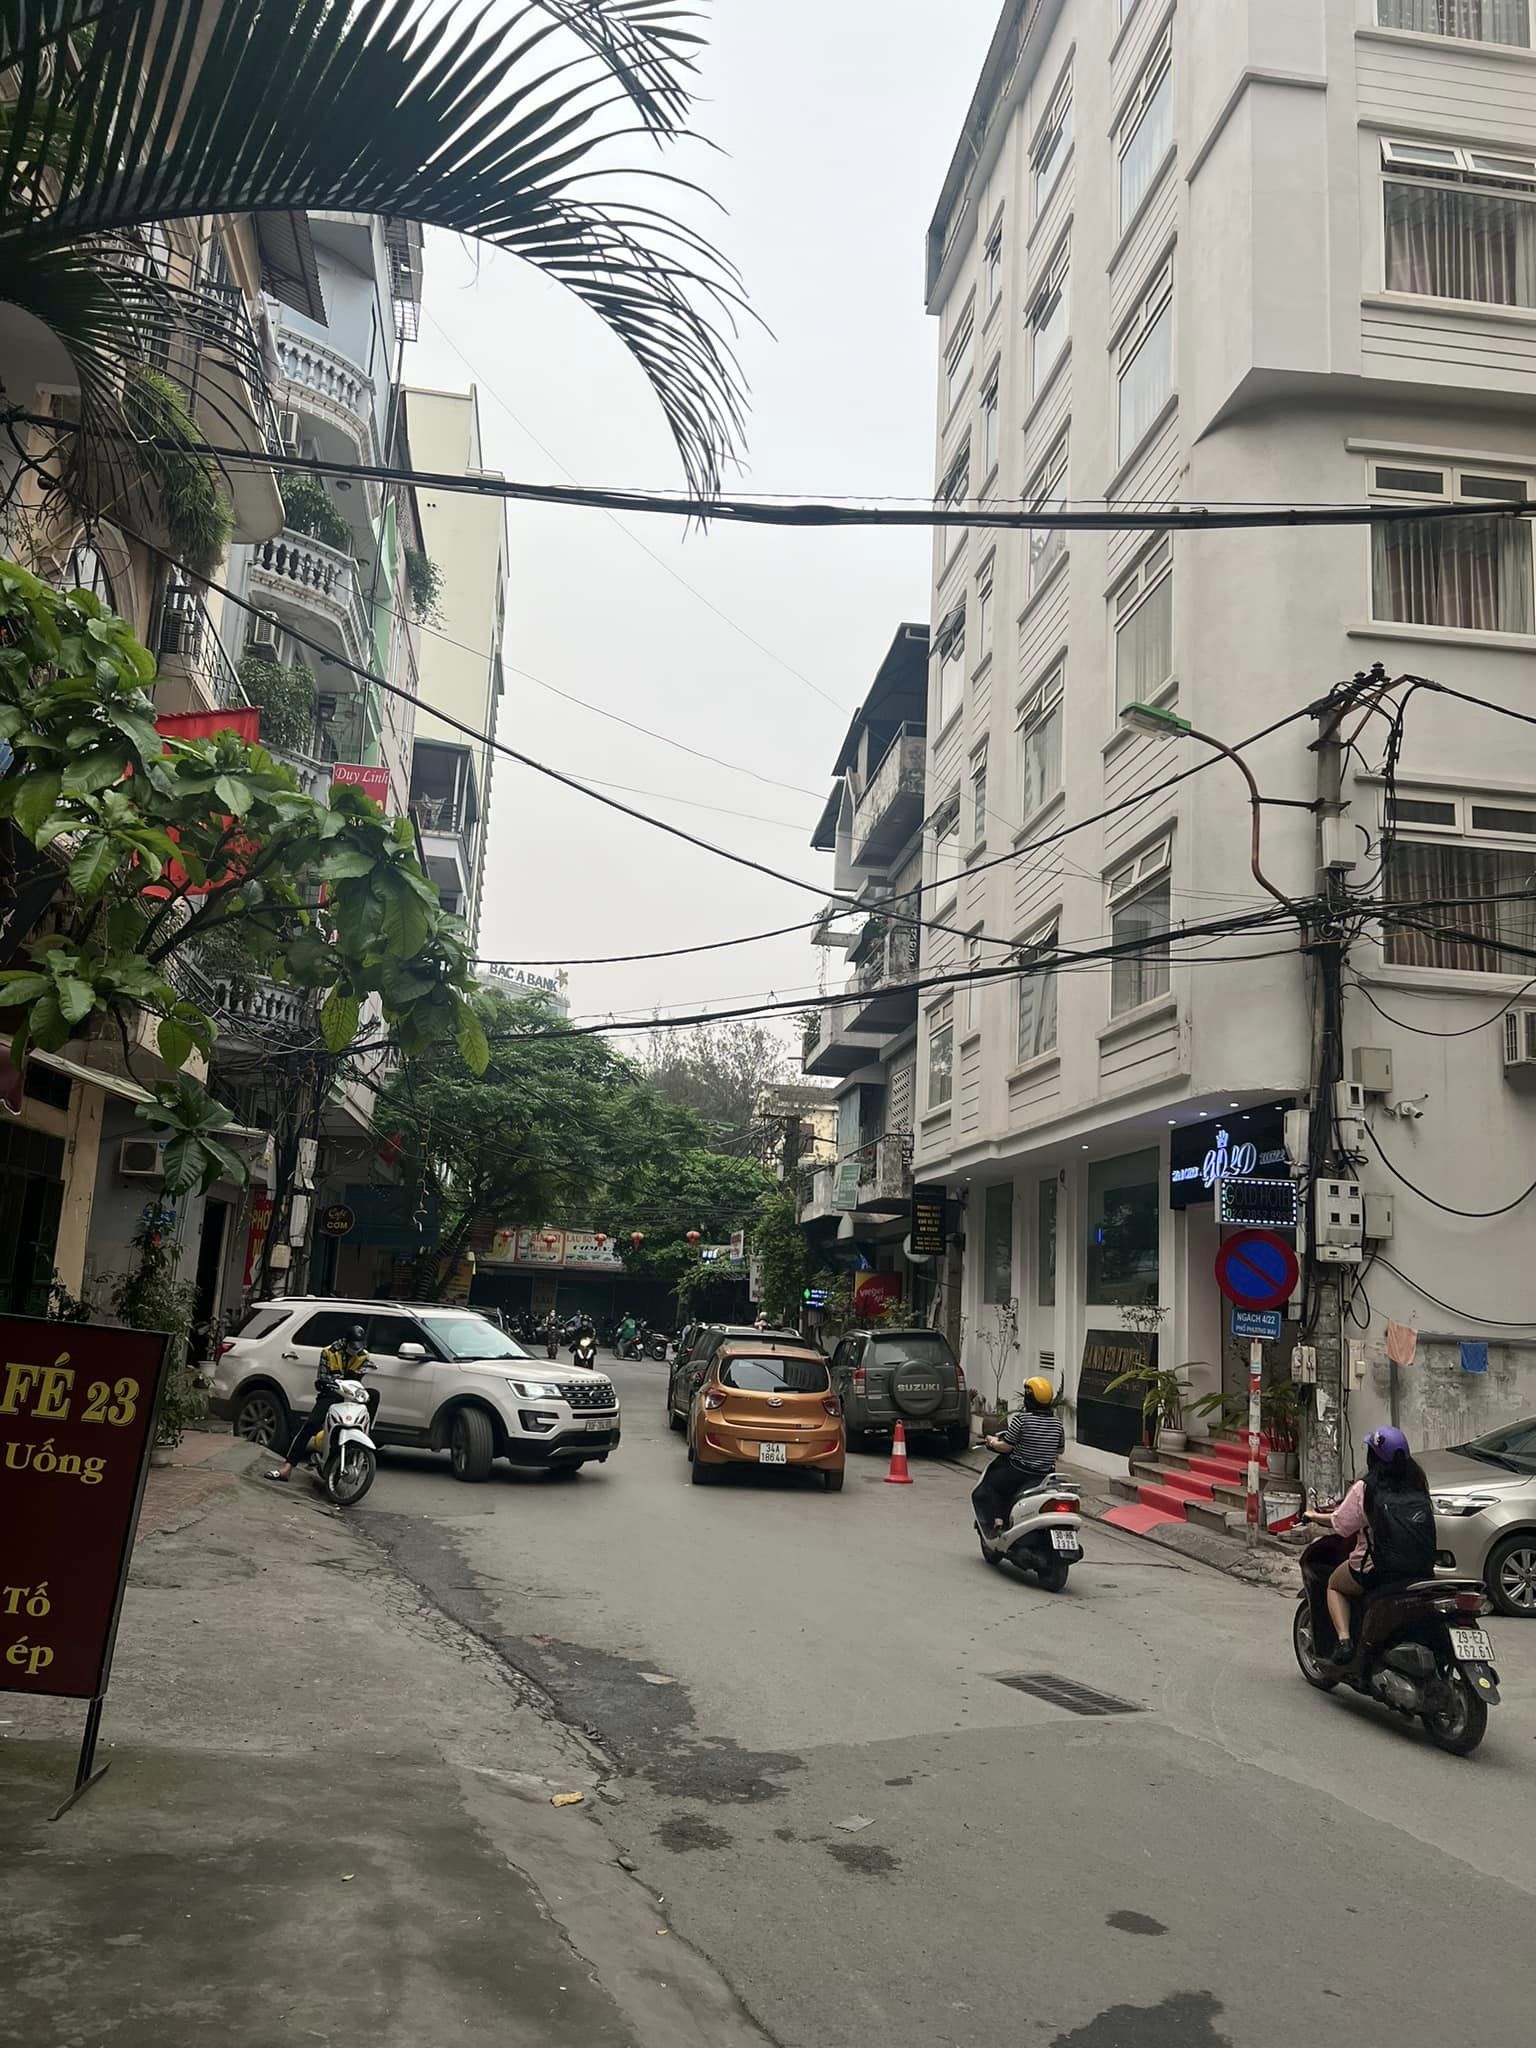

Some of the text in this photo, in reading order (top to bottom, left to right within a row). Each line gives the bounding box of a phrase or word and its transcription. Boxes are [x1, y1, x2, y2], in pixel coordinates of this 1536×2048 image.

[335, 767, 388, 785] Duy Linh
[515, 970, 525, 983] A
[527, 973, 558, 992] BANK
[0, 1352, 140, 1426] FÉ 23
[897, 1383, 940, 1392] SUZUKI
[5, 1438, 107, 1484] Uống
[3, 1581, 51, 1617] Tố
[6, 1635, 54, 1675] ép
